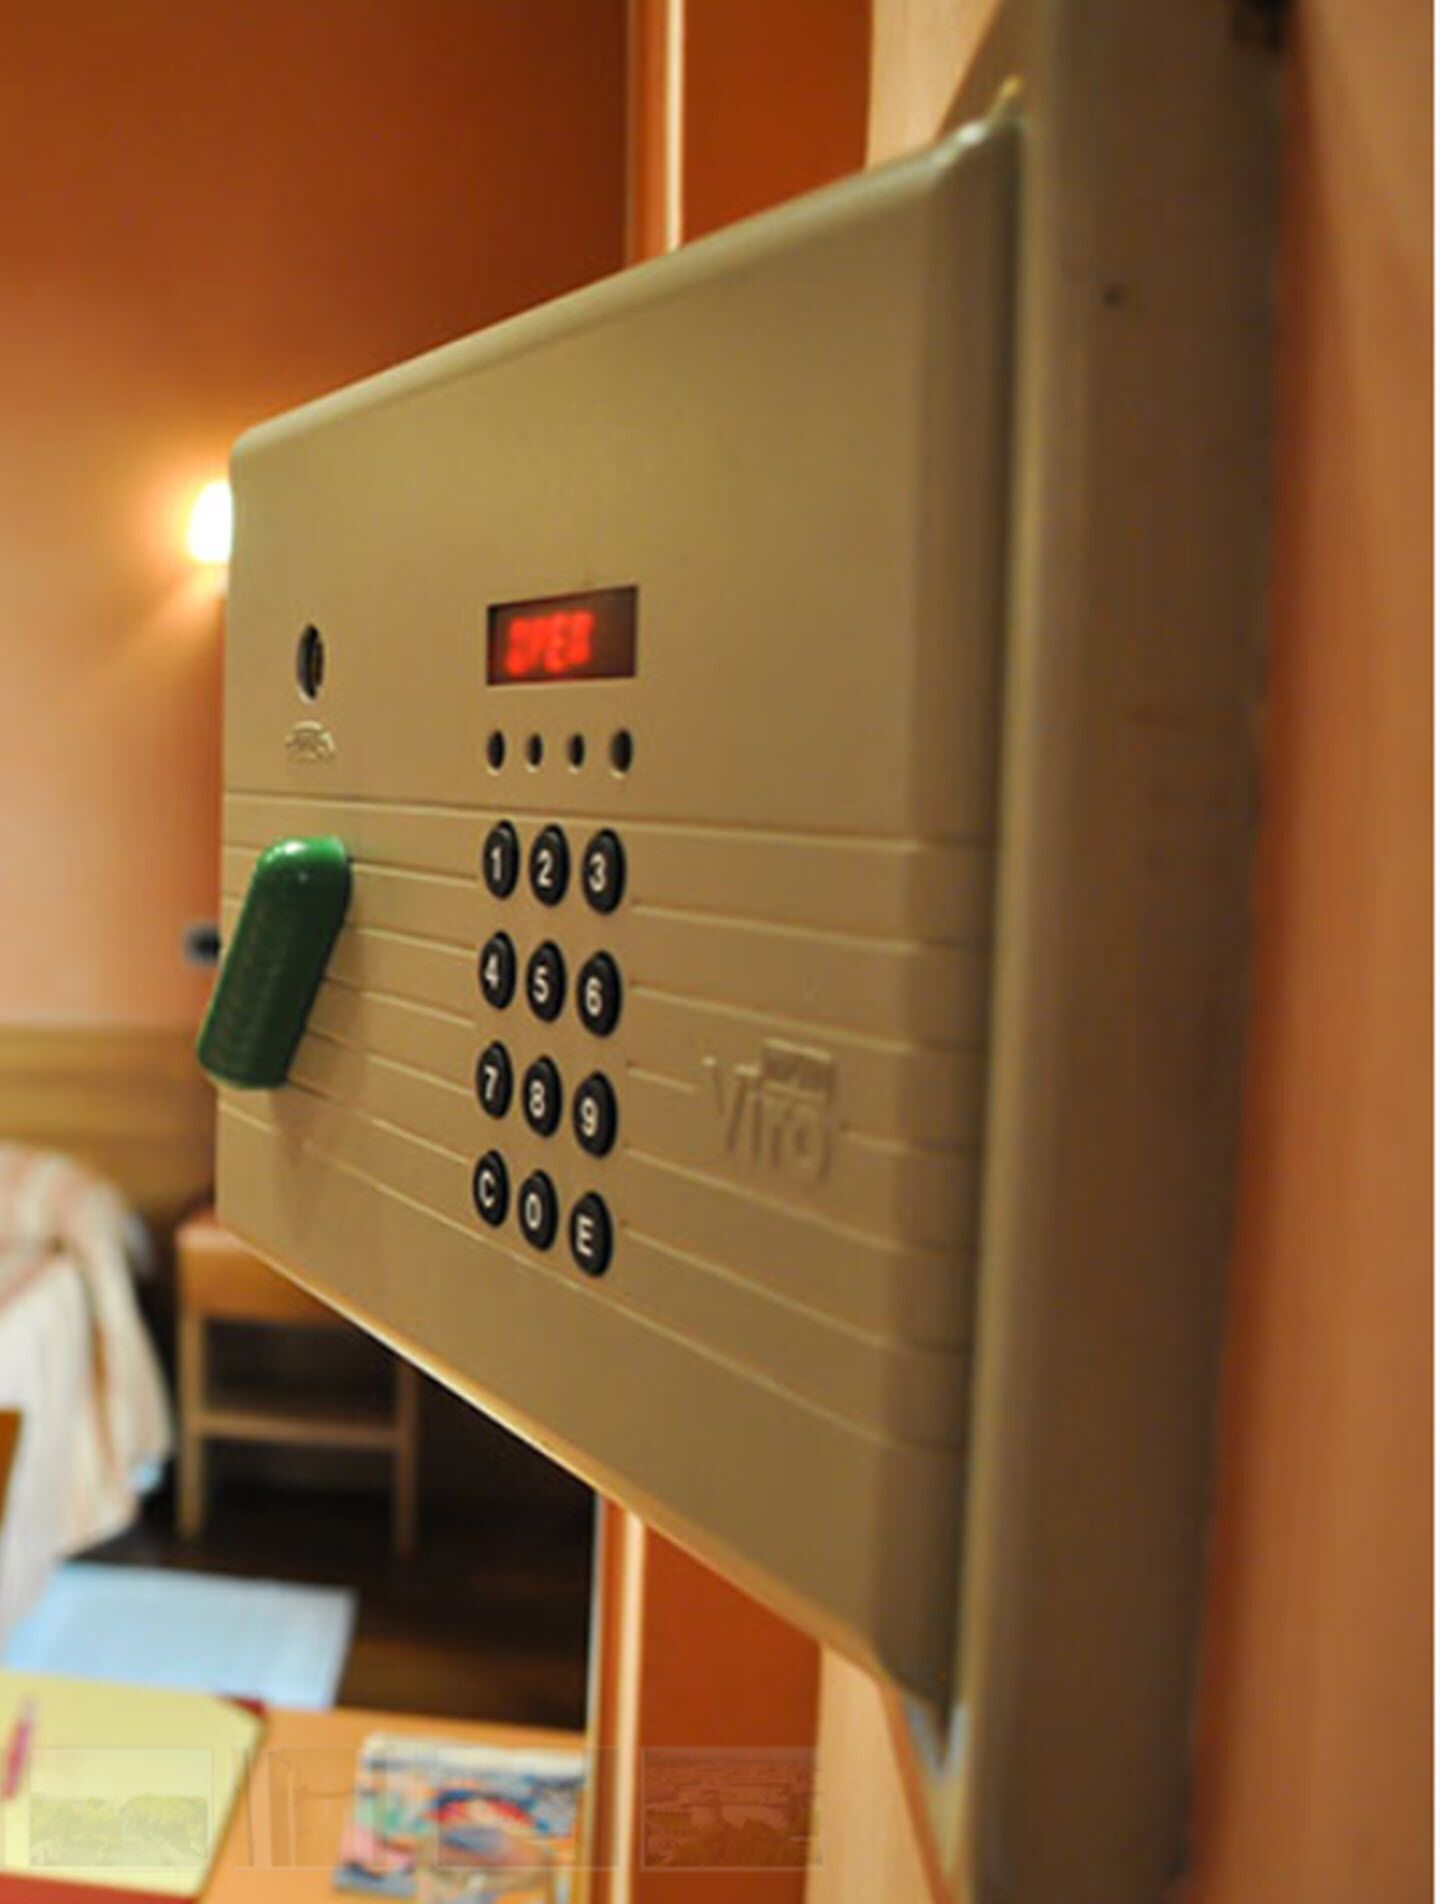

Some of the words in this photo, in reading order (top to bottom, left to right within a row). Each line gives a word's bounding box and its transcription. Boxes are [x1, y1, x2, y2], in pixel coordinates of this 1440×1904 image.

[491, 848, 502, 880] 1
[537, 849, 552, 887] 2
[589, 854, 605, 892] 3
[485, 956, 499, 988] 4
[534, 966, 548, 1003] 5
[585, 977, 602, 1016] 6
[484, 1065, 498, 1100] 7
[529, 1081, 545, 1116] 8
[581, 1097, 597, 1137] 9
[479, 1170, 495, 1207] C
[525, 1193, 541, 1229] 0
[577, 1214, 593, 1257] E
